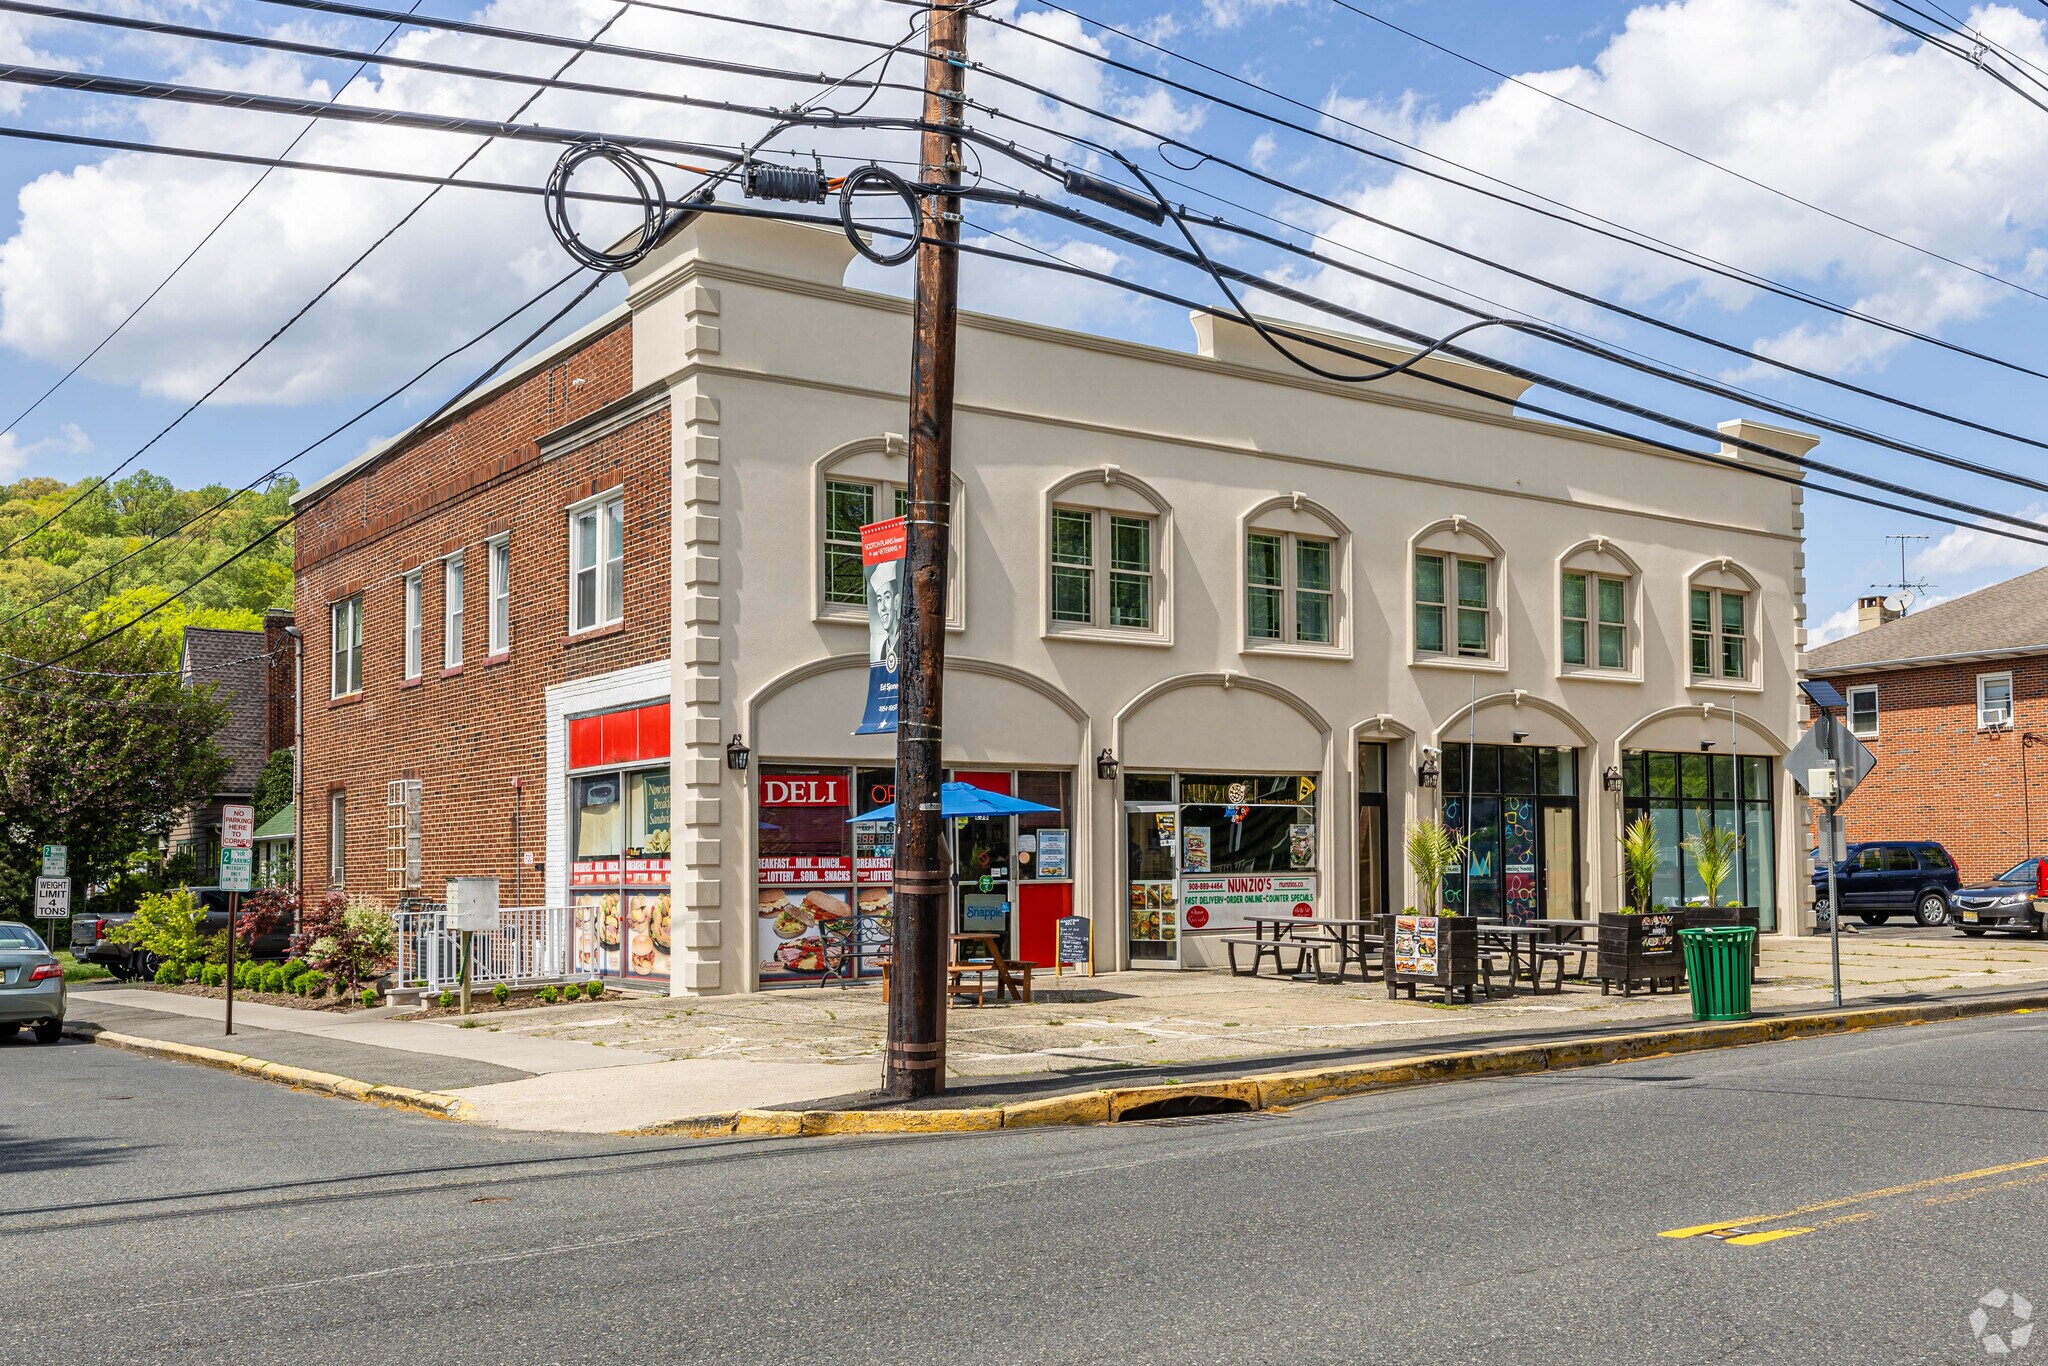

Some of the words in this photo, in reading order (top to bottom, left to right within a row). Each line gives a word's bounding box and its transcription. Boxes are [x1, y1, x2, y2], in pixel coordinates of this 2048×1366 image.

[765, 781, 836, 802] DELI
[224, 851, 229, 862] 2
[1228, 878, 1271, 893] NUNZIO'S
[39, 890, 67, 898] LIMIT
[1185, 896, 1198, 905] FAST
[1291, 893, 1313, 902] SPECIALS
[49, 899, 57, 907] 4
[39, 907, 66, 915] TONS
[966, 905, 1003, 920] Snapple
